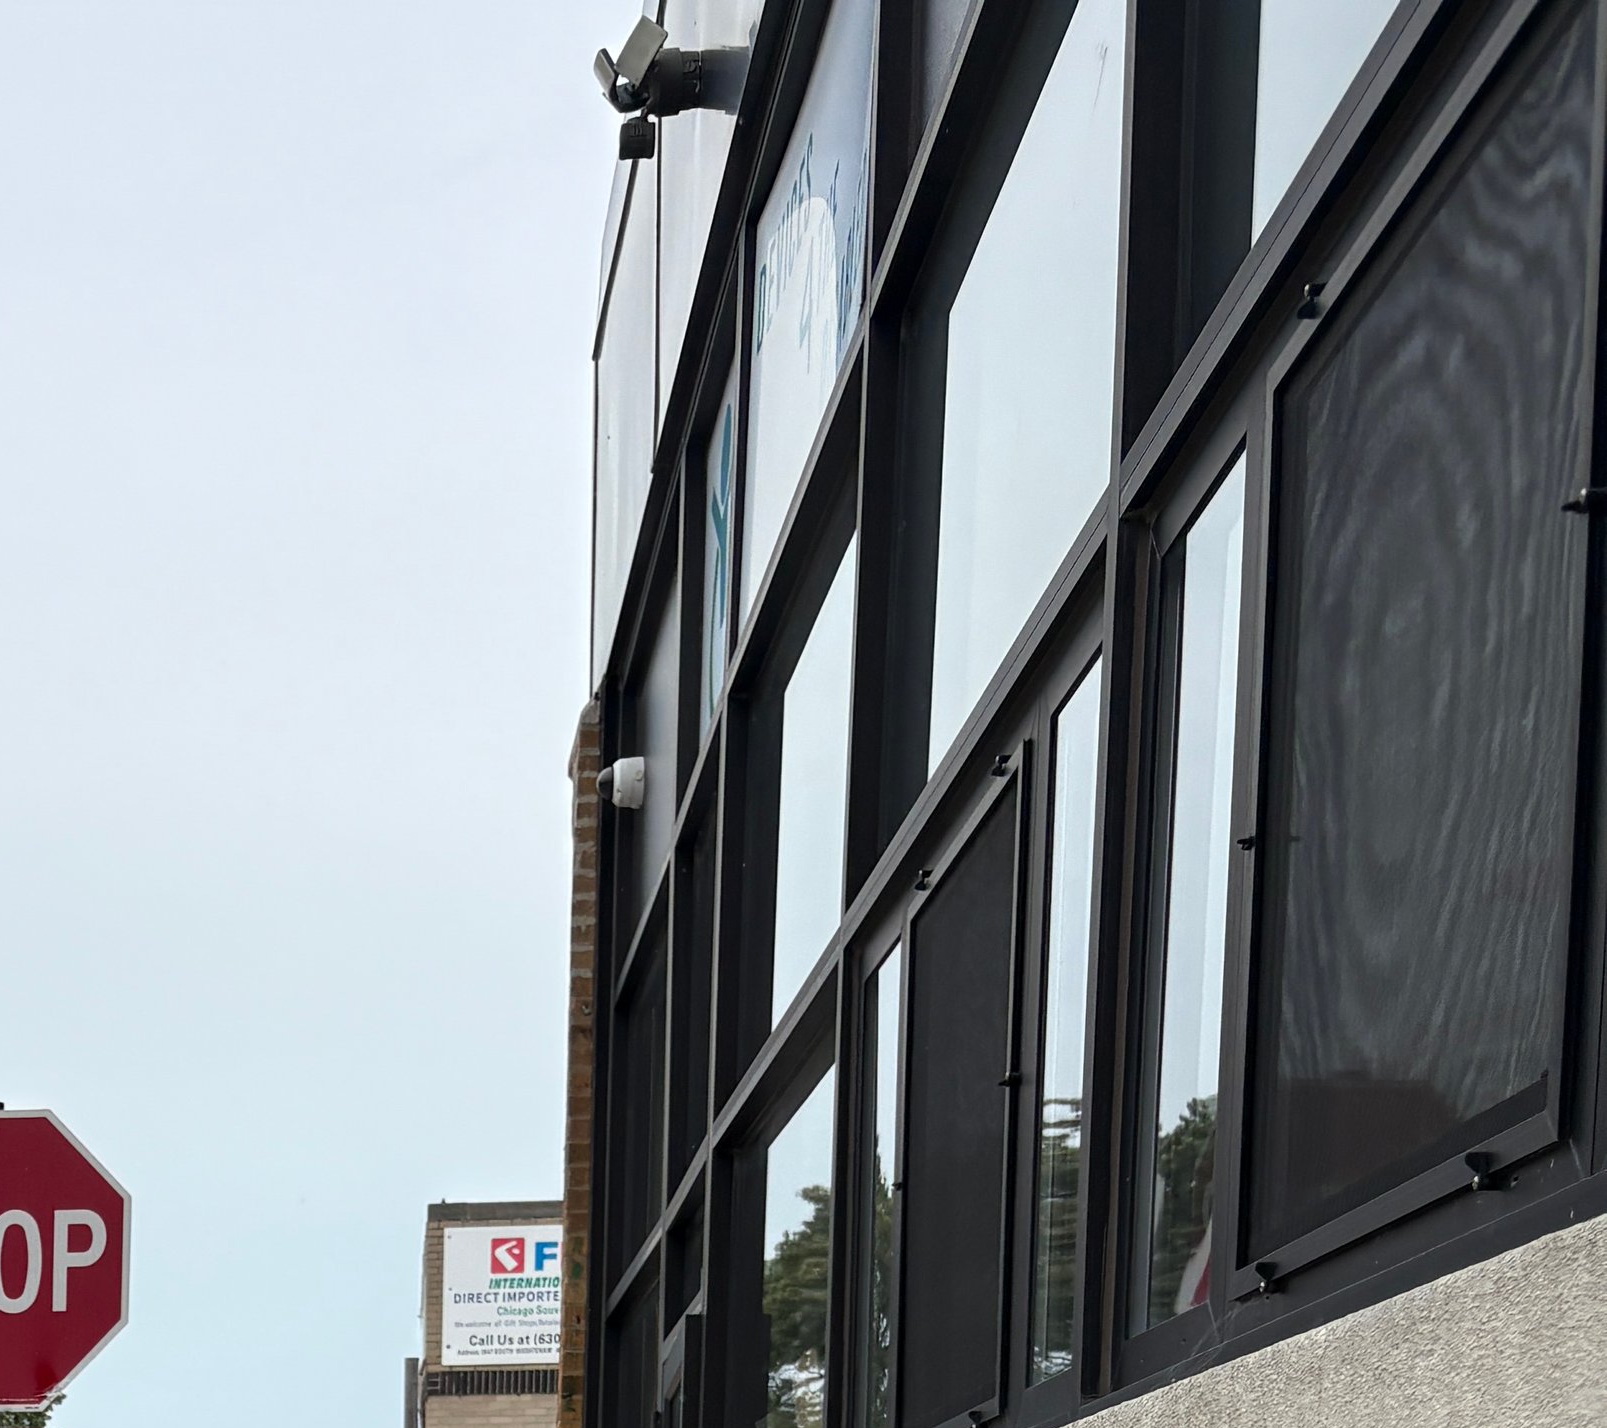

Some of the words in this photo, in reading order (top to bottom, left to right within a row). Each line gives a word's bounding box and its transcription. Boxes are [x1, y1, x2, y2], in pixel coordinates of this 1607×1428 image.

[454, 1292, 499, 1304] DIRECT
[496, 1306, 534, 1317] Chicago
[469, 1335, 494, 1346] Call
[497, 1334, 514, 1346] Us
[517, 1334, 530, 1345] at
